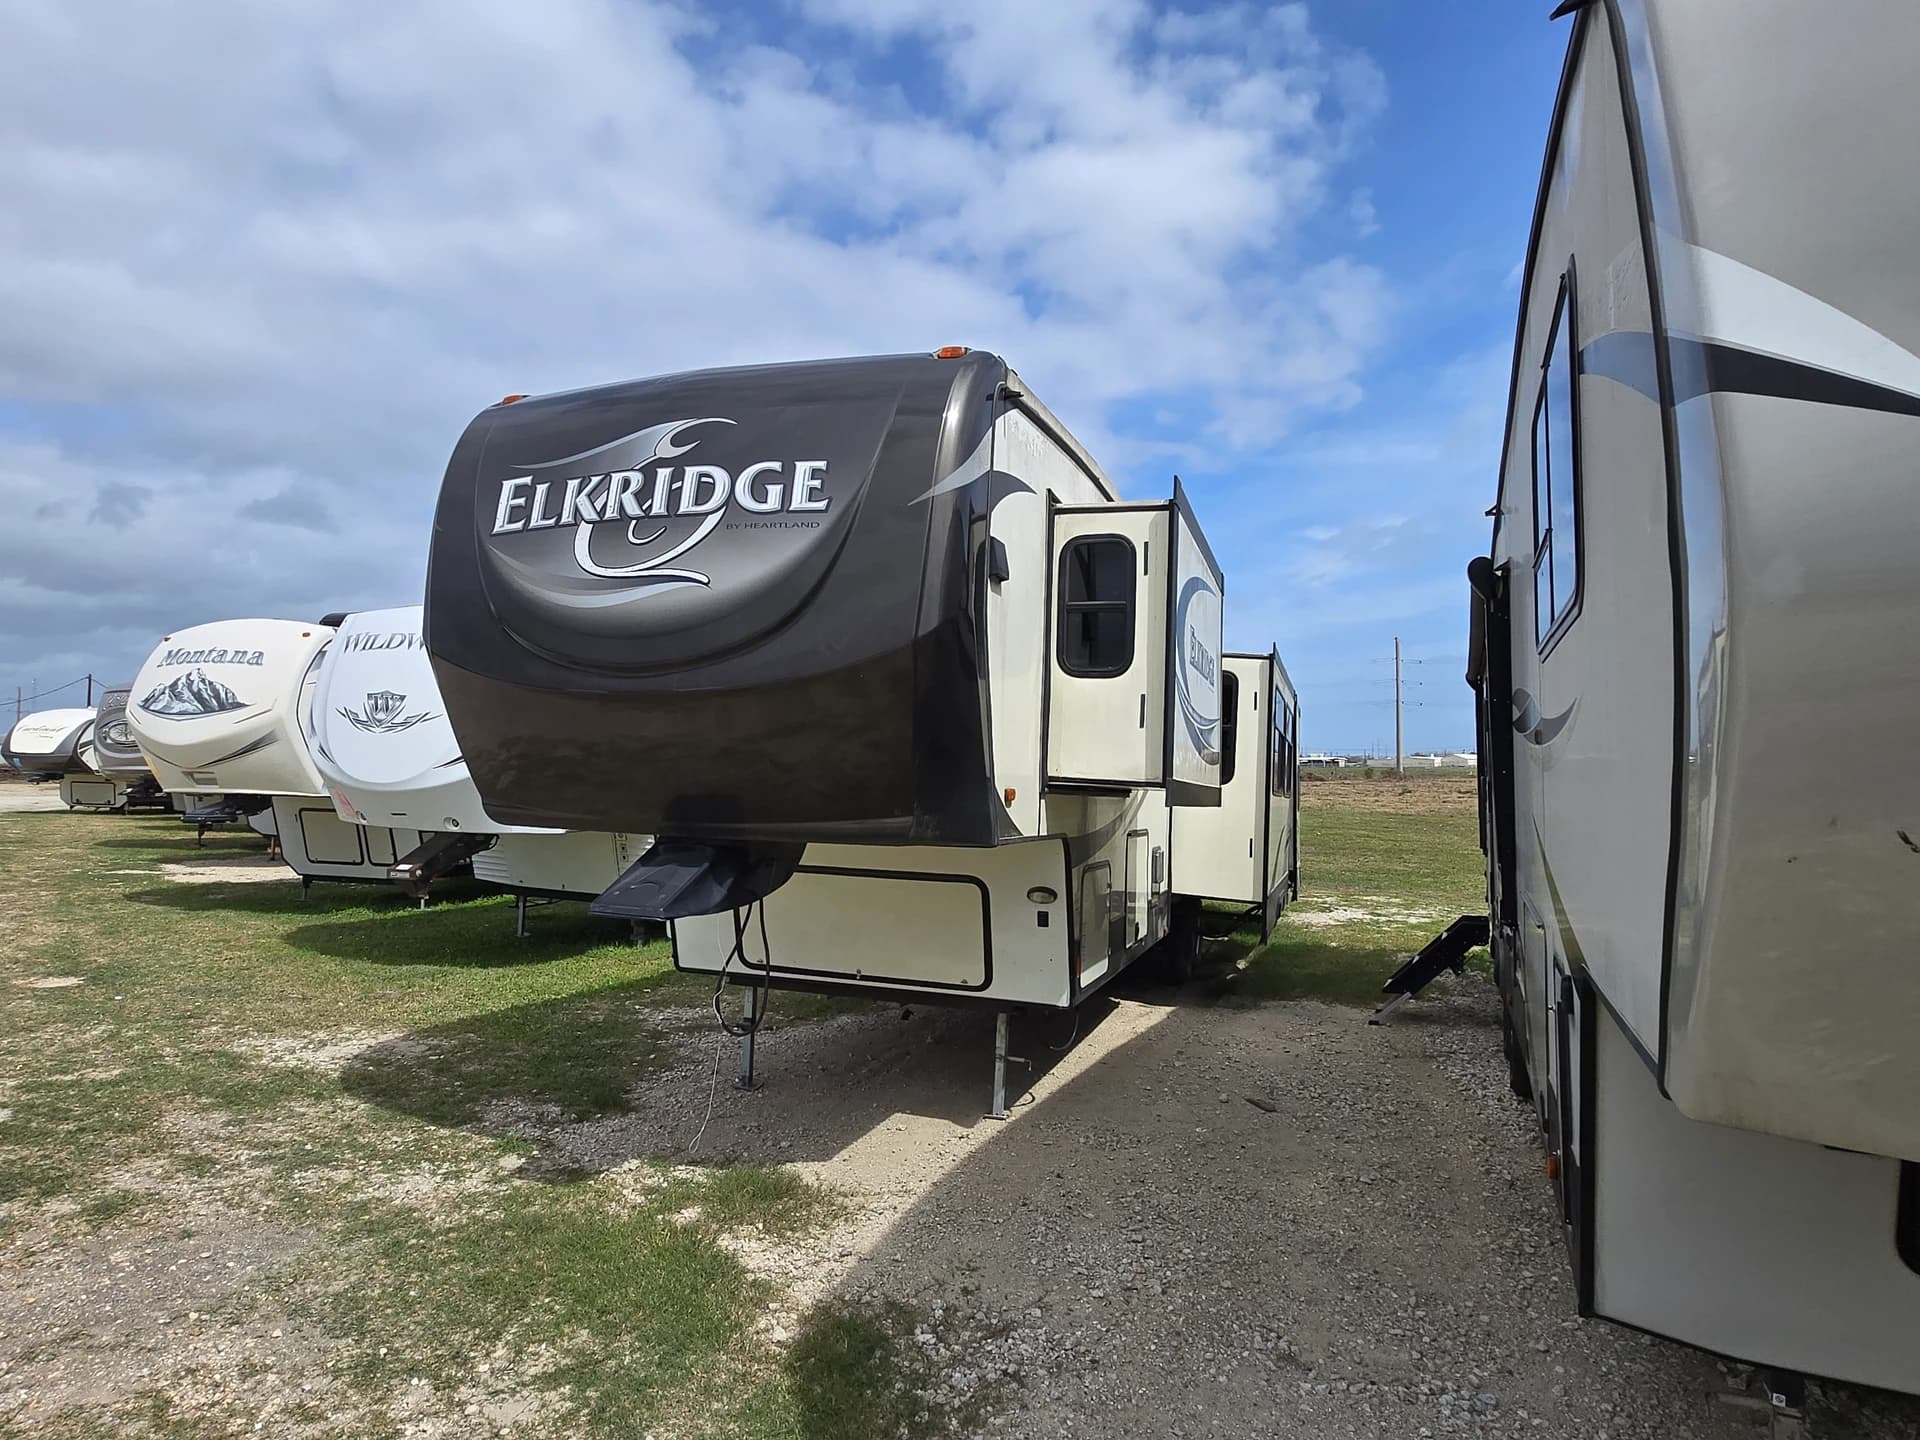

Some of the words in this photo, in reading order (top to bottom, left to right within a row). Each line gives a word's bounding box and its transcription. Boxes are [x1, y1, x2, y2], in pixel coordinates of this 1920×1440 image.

[490, 460, 832, 537] ELKRIDGE
[744, 521, 820, 529] HEARTLAND
[157, 646, 264, 668] Montana
